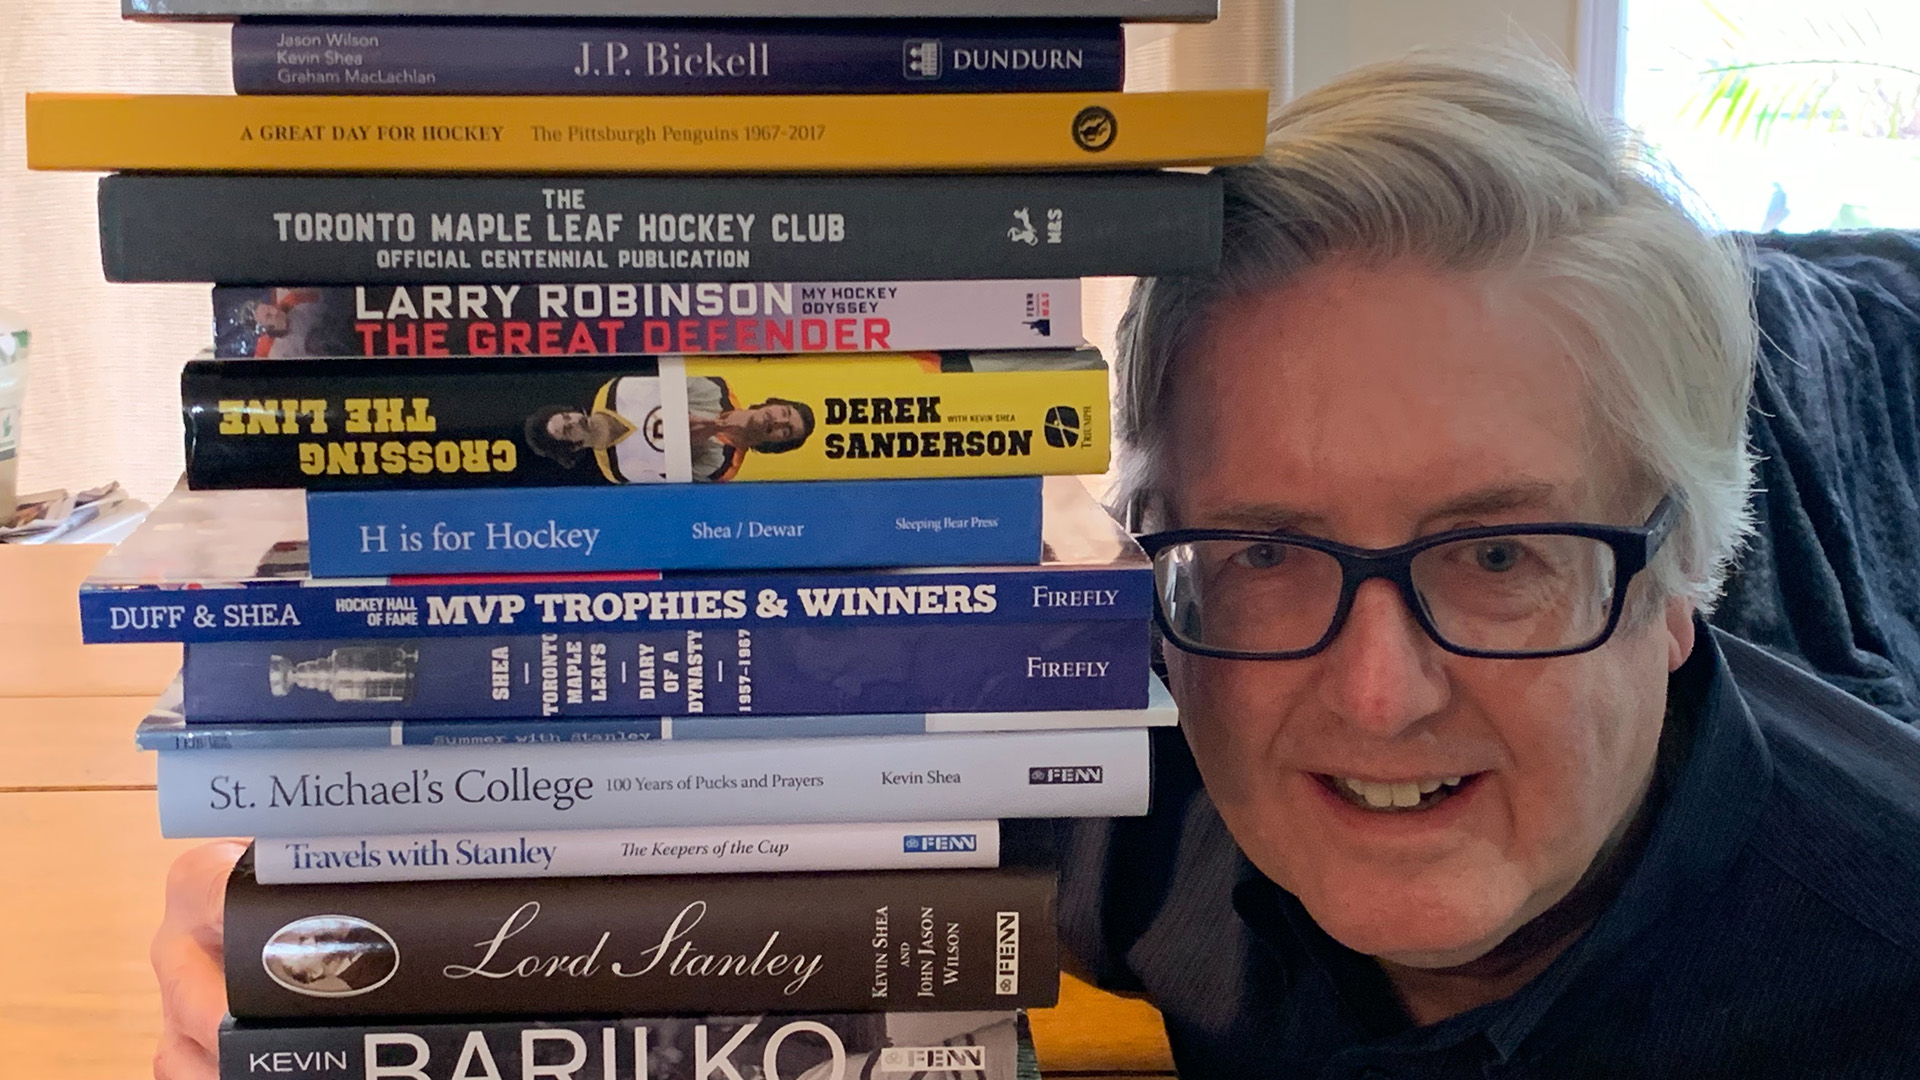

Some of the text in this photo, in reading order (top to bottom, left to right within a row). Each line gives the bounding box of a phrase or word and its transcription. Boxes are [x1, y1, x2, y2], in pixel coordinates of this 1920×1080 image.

[277, 33, 378, 47] Jason Wilson
[277, 50, 362, 65] Kevin Shea
[575, 42, 767, 75] J.P. Bickell
[955, 50, 1082, 69] DUNDURN
[278, 68, 435, 83] Graham MacLachlan
[239, 125, 503, 141] A GREAT DAY FOR HOCKEY
[529, 122, 562, 141] The
[569, 126, 656, 144] Pittsburgh
[663, 126, 738, 144] Penguins
[542, 189, 585, 209] THE
[274, 213, 844, 242] TORONTO MAPLE LEAF HOCKEY CLUB
[377, 250, 749, 268] OFFICIAL CENTENNIAL PUBLICATION
[356, 283, 791, 319] LARRY ROBINSON
[802, 288, 896, 300] MY HOCKEY
[802, 302, 878, 314] ODYSSEY
[355, 318, 890, 356] THE GREAT DEFENDER
[218, 398, 436, 434] THE LINE
[825, 397, 941, 425] DEREK
[947, 414, 1016, 423] WITH KEVIN SHEA
[826, 430, 1032, 459] SANDERSON
[299, 440, 517, 474] CROSSING
[693, 522, 731, 539] Shea
[749, 522, 804, 537] Dewar
[896, 517, 998, 532] Sleeping Bear Press
[361, 520, 600, 555] H is for Hockey
[336, 597, 417, 612] HOCKEY HALL
[427, 585, 996, 625] MVP TROPHIES & WINNERS
[1033, 586, 1118, 607] FIREFLY
[110, 604, 300, 629] DUFF & SHEA
[366, 611, 419, 626] OF FAME
[492, 647, 509, 700] SHEA
[566, 642, 582, 703] MAPLE
[591, 644, 606, 701] LEAFS
[639, 644, 655, 699] DIARY
[663, 651, 679, 692] OF A
[687, 630, 703, 712] DYNASTY
[1028, 657, 1109, 677] FIREFLY
[434, 732, 650, 746] Summer with Stanley
[608, 774, 823, 791] 100 Years of Pucks and Prayers
[882, 770, 960, 784] Kevin Shea
[1048, 768, 1100, 781] FENN
[210, 767, 593, 810] St. Michael's College
[286, 838, 557, 871] Travels with Stanley
[623, 841, 788, 859] The Keepers of the Cup
[922, 837, 976, 849] FENN
[444, 901, 822, 994] Lord Stanley
[872, 906, 888, 997] KEVIN SHEA
[900, 941, 910, 968] AND
[918, 907, 935, 996] JOHN JASON
[944, 923, 959, 984] WILSON
[999, 916, 1015, 975] FENN
[250, 1051, 346, 1072] KEVIN
[907, 1049, 981, 1067] FENN
